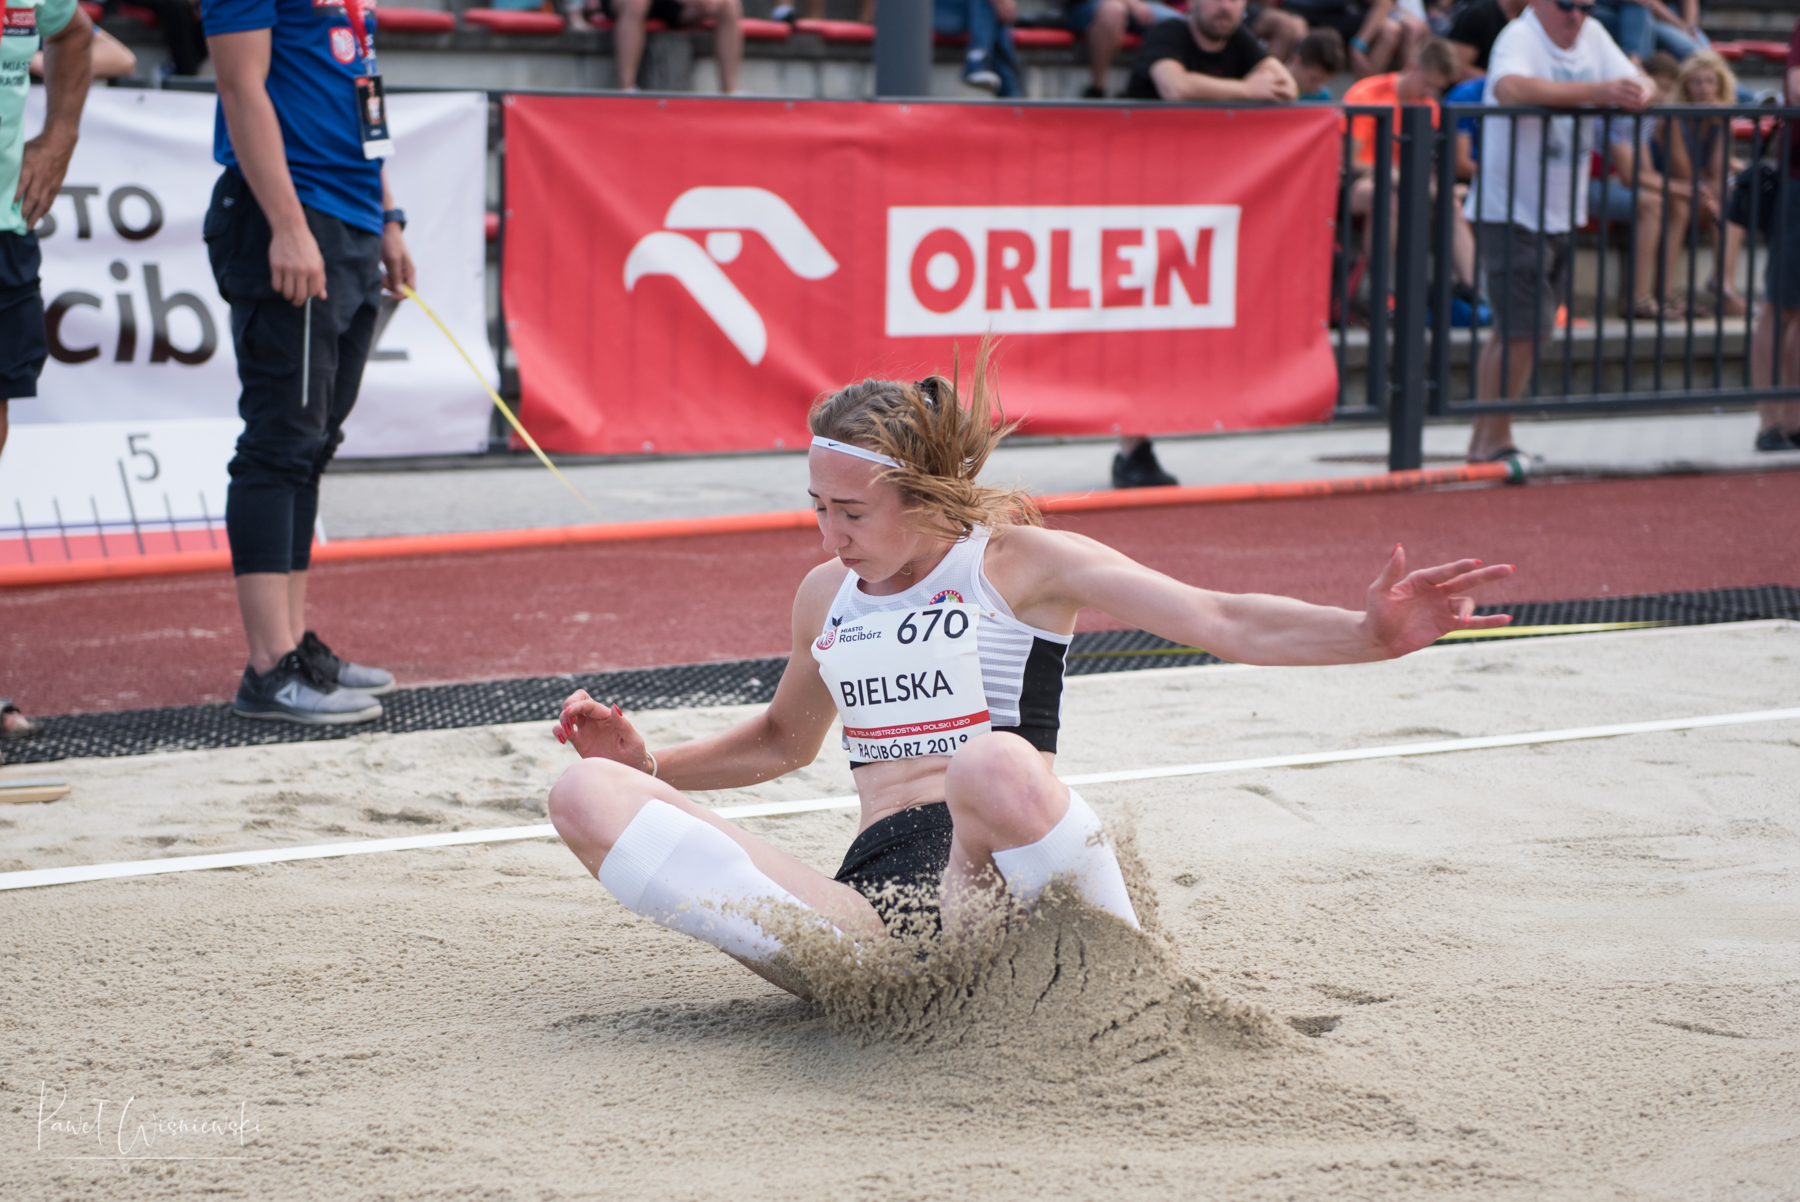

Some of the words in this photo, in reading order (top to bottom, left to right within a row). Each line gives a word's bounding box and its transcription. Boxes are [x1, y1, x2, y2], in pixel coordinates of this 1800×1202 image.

[909, 227, 1215, 314] ORLEN
[127, 432, 161, 482] 5
[839, 630, 882, 643] Racibórz
[840, 625, 864, 634] MIASTO
[897, 608, 969, 645] 670
[840, 669, 954, 707] BIELSKA
[869, 726, 922, 737] MISTRZOSTWA
[923, 722, 952, 731] POLSKI
[953, 718, 971, 727] U20
[858, 739, 923, 760] RACIBÓRZ
